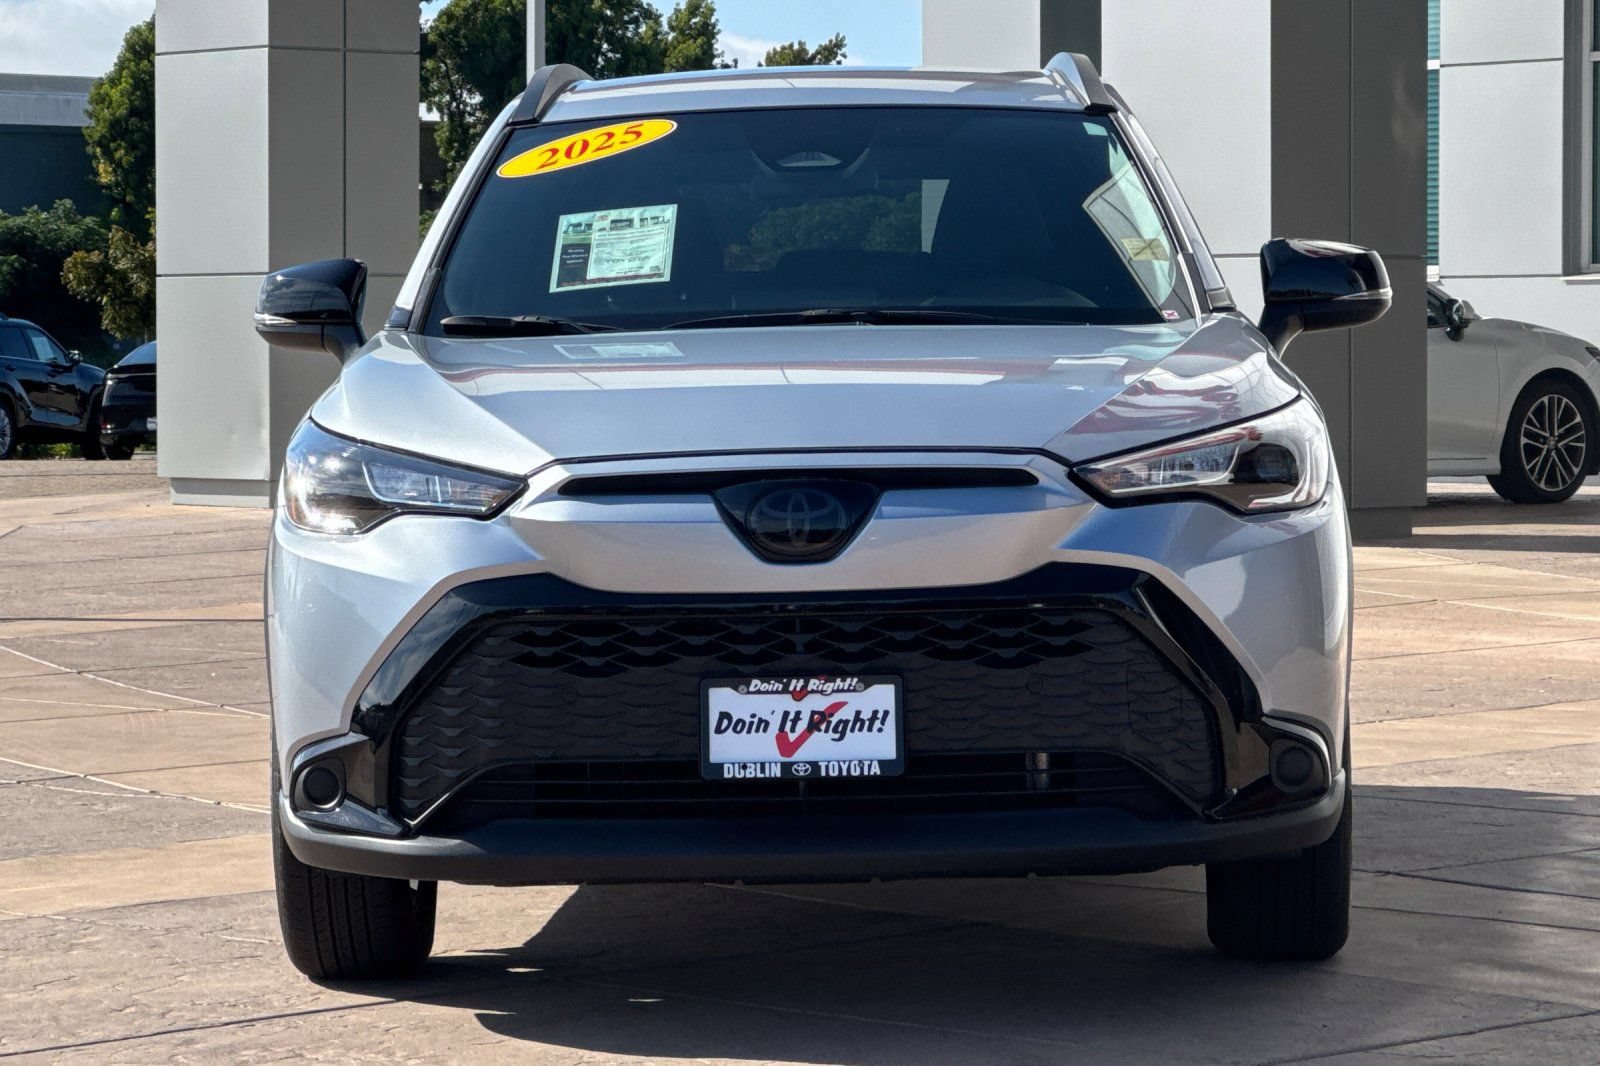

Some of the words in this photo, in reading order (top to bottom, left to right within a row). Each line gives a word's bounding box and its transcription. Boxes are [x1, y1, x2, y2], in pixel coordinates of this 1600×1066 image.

[536, 121, 644, 170] 2025
[749, 679, 787, 692] Doin'
[789, 679, 805, 692] It
[807, 678, 858, 694] Right!
[714, 710, 775, 735] Doin'
[778, 710, 802, 734] It
[806, 709, 890, 742] Right!
[723, 763, 781, 778] DUBLIN
[818, 760, 881, 776] TOYOTA
